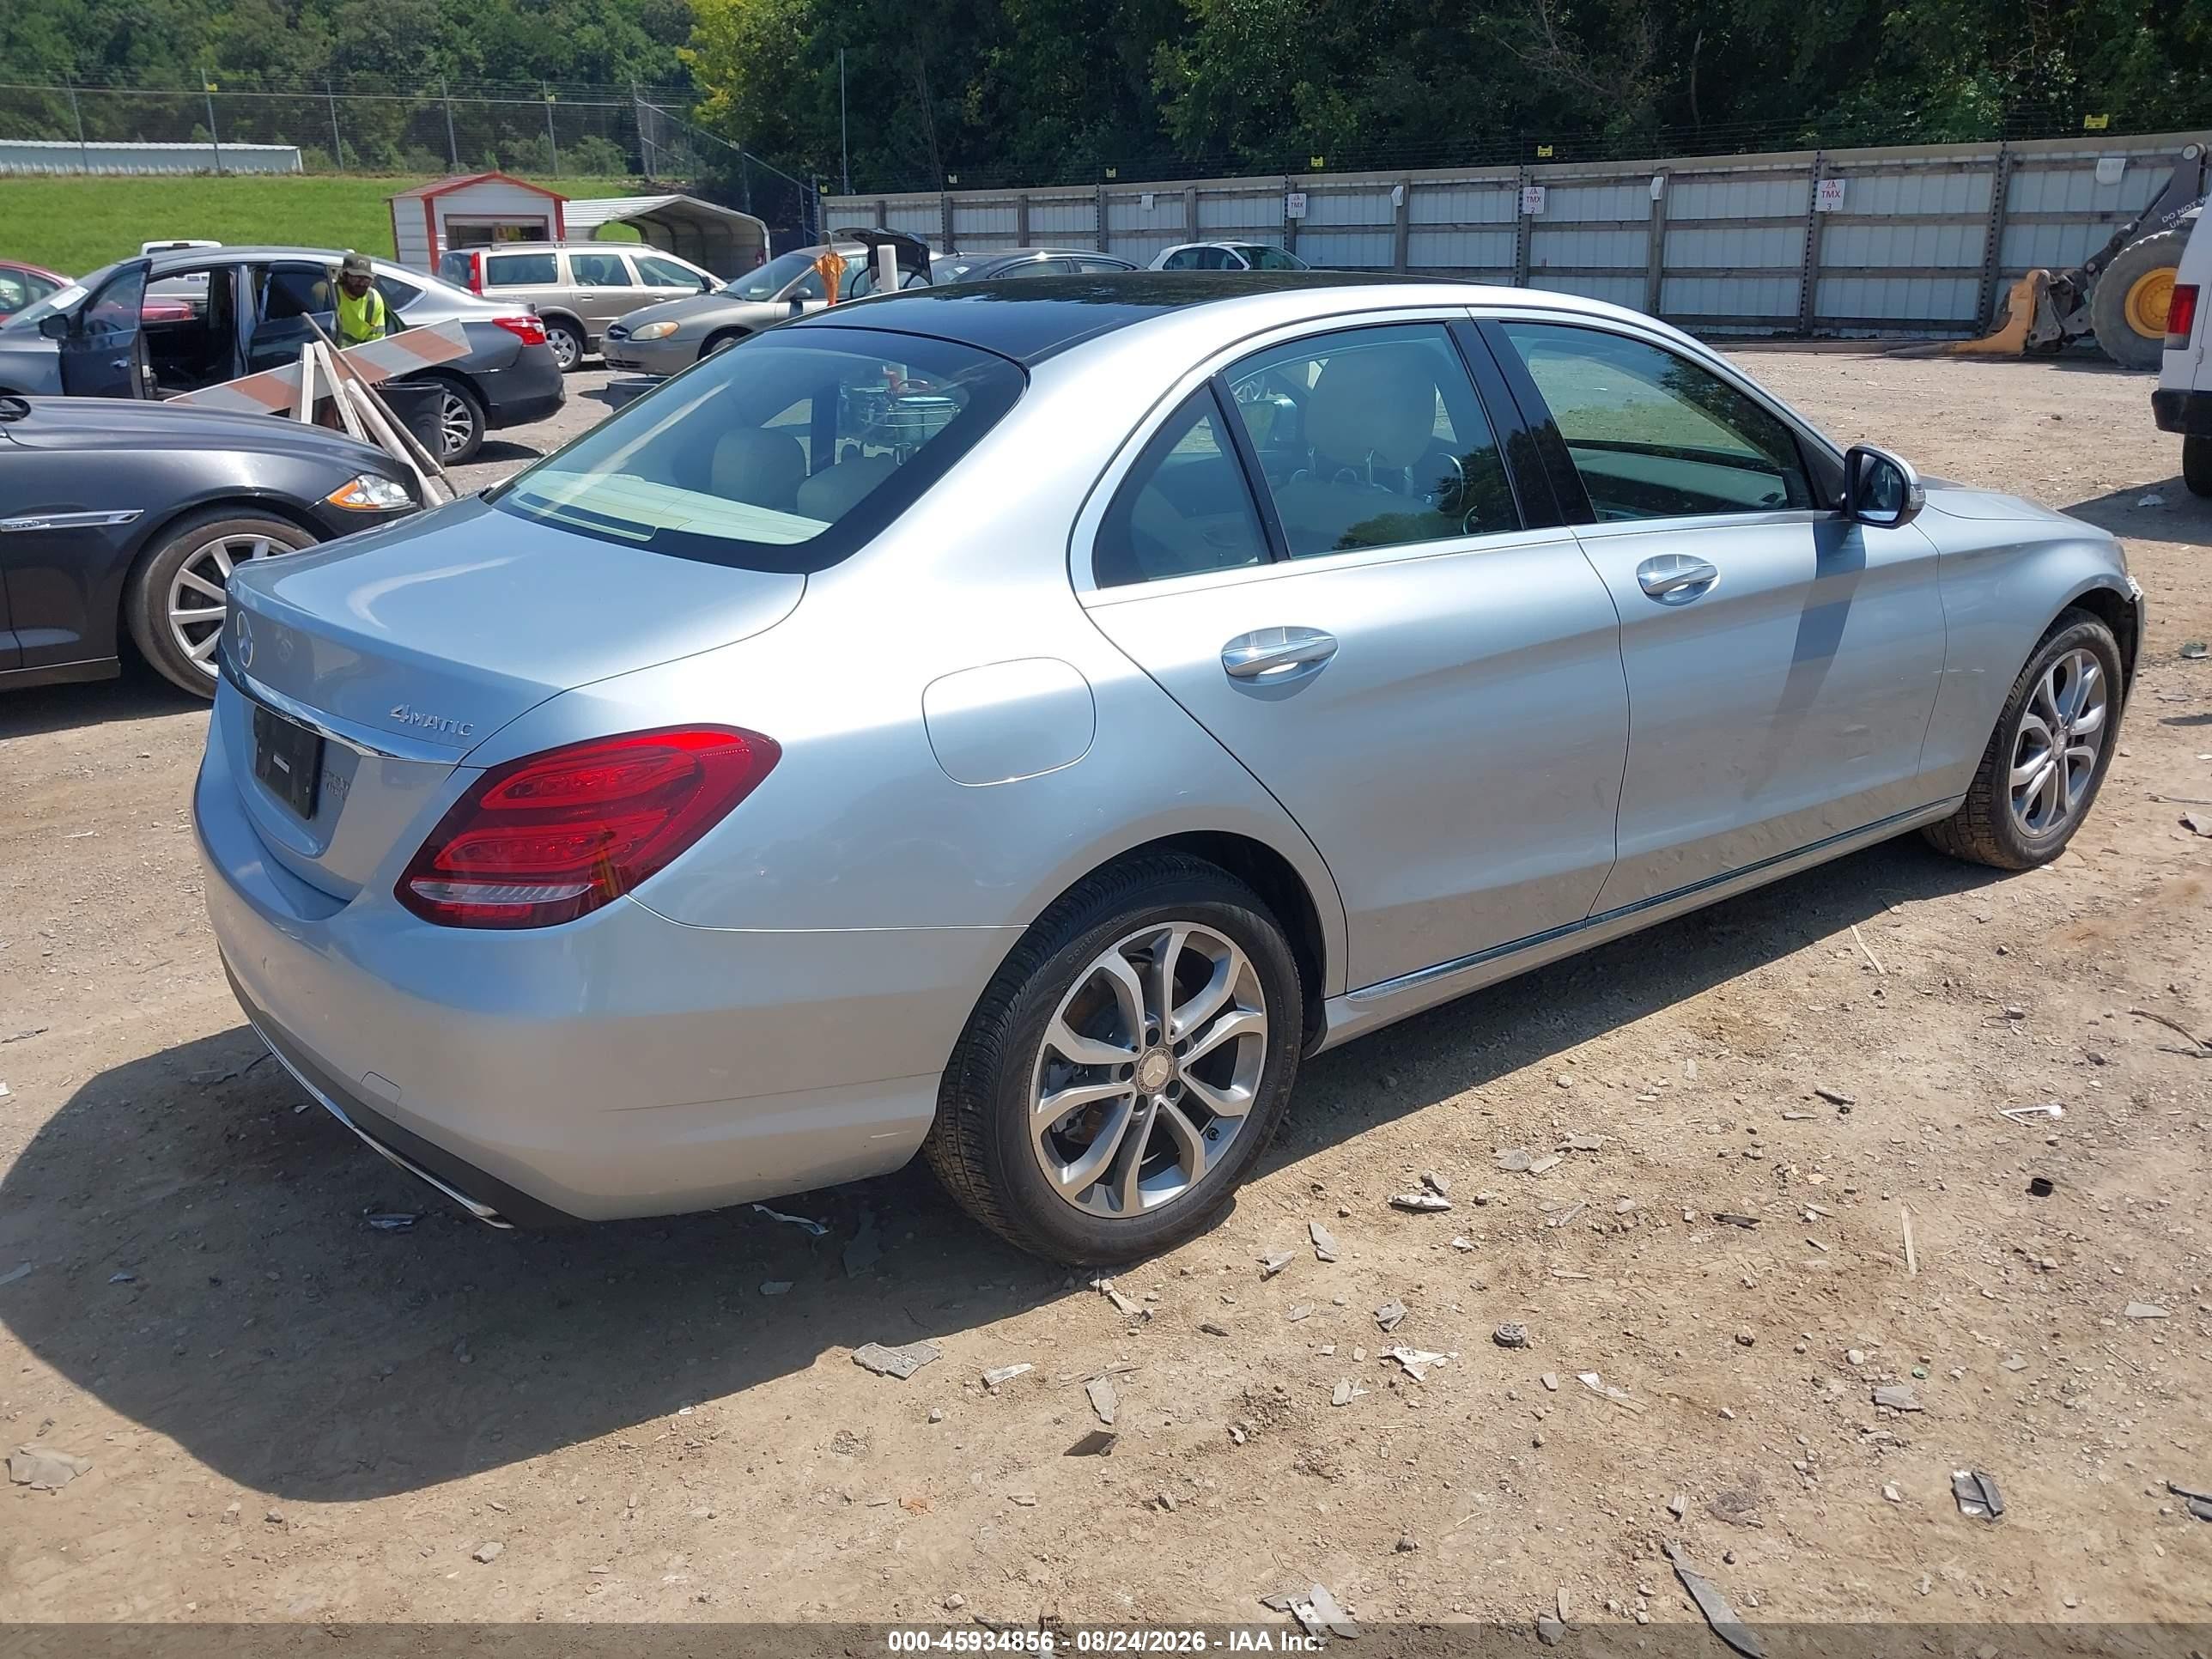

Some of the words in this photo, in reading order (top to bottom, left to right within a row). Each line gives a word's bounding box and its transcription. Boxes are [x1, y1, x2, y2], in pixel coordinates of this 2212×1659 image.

[1821, 190, 1841, 198] TMX
[2161, 212, 2176, 222] DO
[2177, 200, 2197, 216] NOT
[390, 703, 474, 737] 4MATIC
